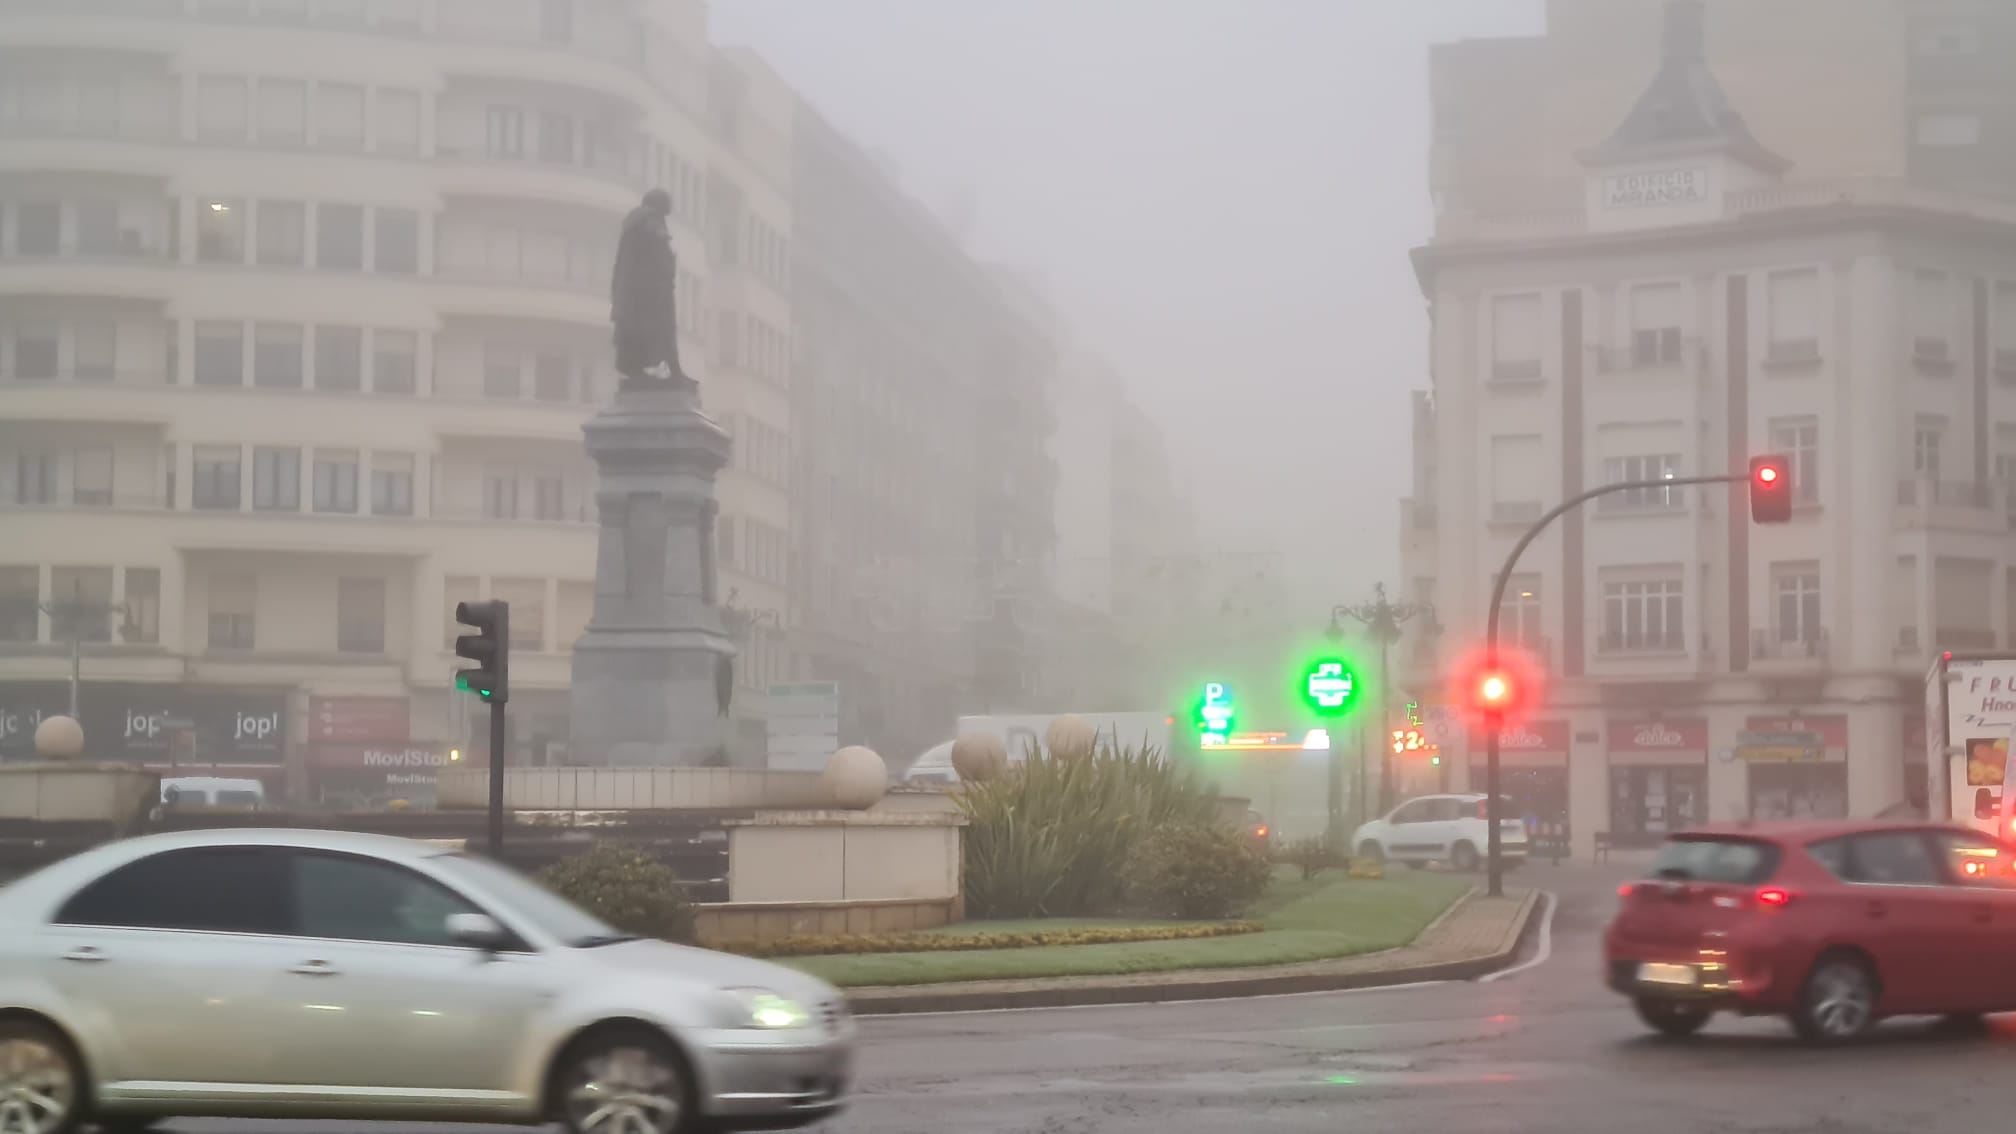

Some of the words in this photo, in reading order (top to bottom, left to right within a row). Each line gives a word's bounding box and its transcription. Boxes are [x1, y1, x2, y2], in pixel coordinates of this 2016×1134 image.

[1611, 186, 1697, 206] MIRANDA
[1981, 697, 2016, 712] Hno
[0, 708, 41, 738] jo!
[233, 711, 278, 739] jop!
